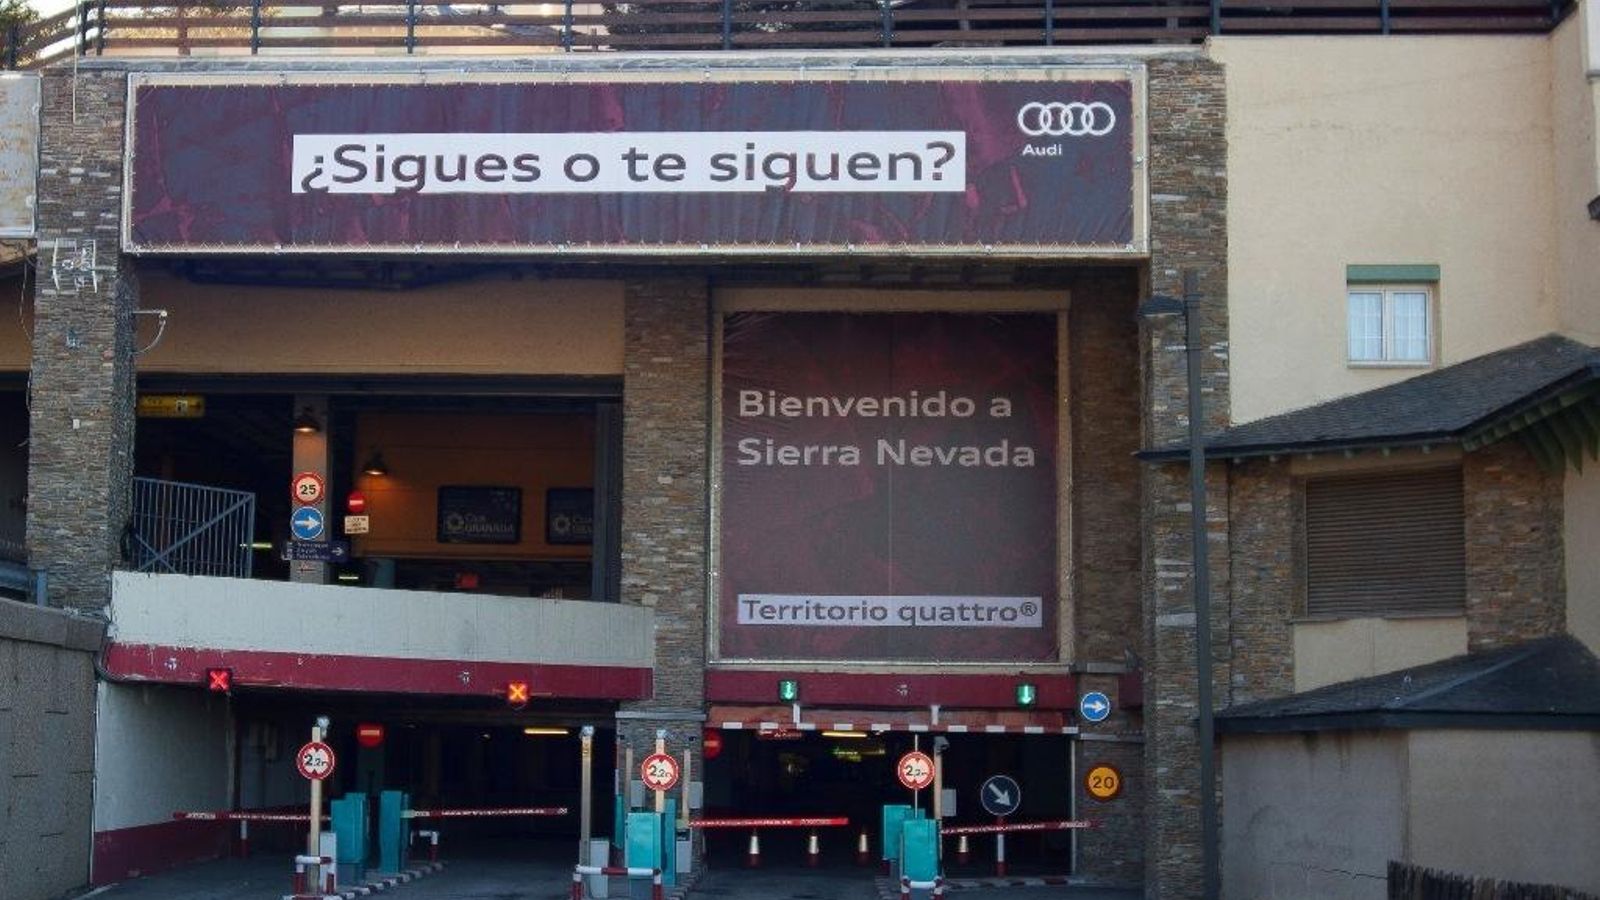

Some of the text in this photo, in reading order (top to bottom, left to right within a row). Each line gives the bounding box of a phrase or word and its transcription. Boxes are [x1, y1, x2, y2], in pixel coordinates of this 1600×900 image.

[1022, 143, 1063, 156] Audi
[301, 140, 956, 194] ¿Sigues o te siguen?
[738, 389, 1013, 418] Bienvenido a
[736, 437, 1036, 467] Sierra Nevada
[299, 484, 317, 495] 25
[741, 599, 889, 621] Territorio
[1093, 775, 1115, 789] 20
